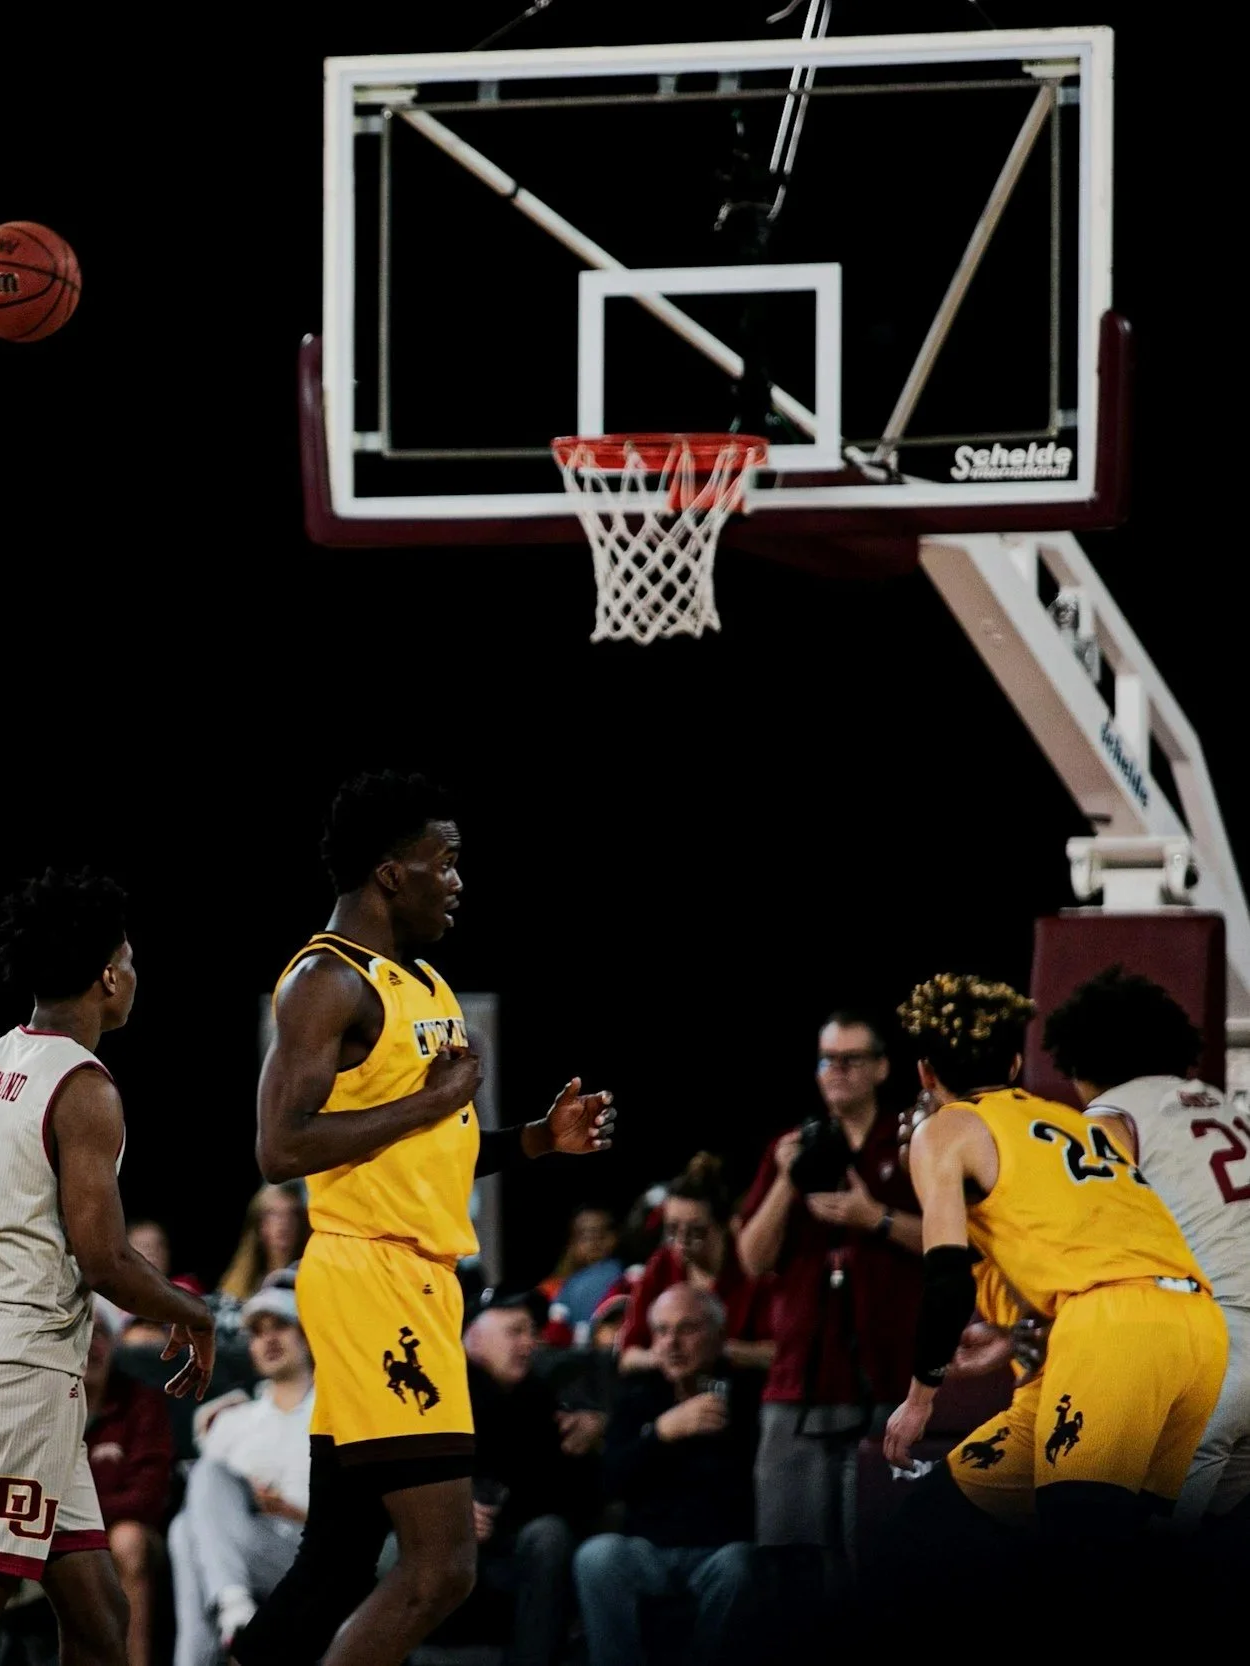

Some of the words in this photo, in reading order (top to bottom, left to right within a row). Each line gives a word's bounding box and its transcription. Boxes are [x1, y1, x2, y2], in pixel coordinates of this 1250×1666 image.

[950, 441, 1073, 481] Schelde
[1030, 1119, 1150, 1187] 24
[1191, 1117, 1250, 1203] 2
